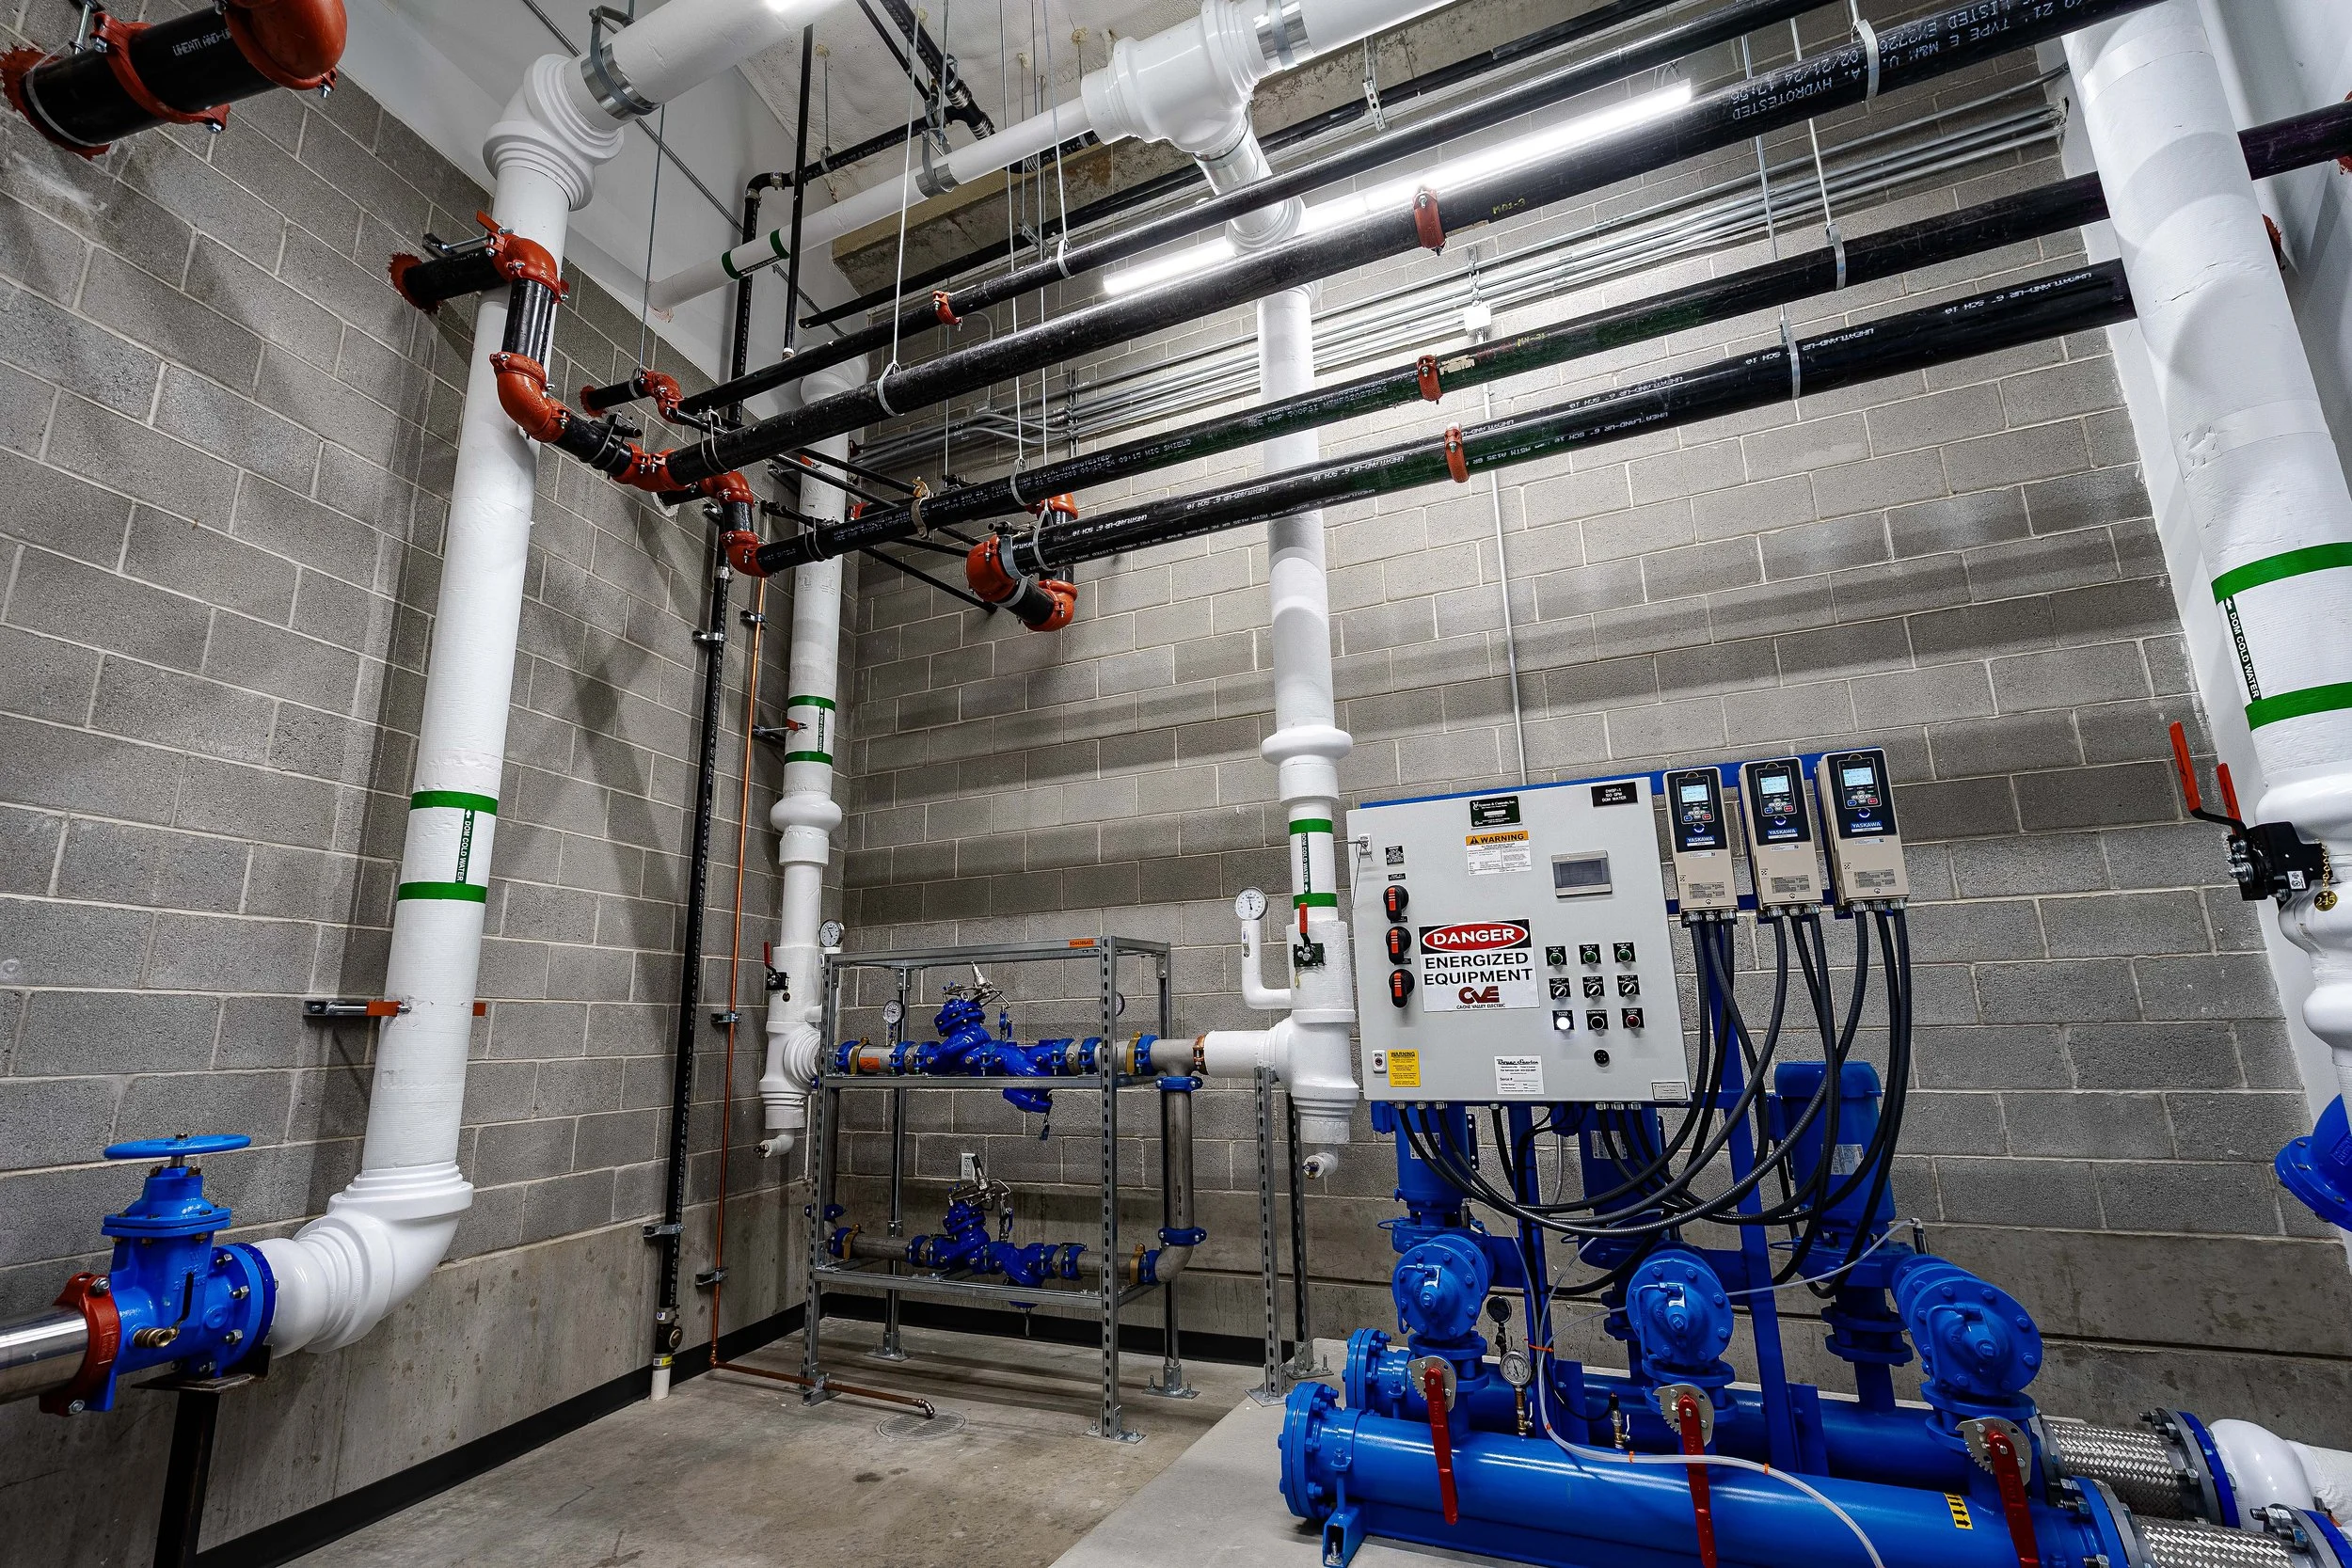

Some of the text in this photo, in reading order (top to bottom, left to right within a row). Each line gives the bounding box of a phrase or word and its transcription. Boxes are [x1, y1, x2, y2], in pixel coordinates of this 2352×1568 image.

[1966, 17, 2010, 40] TYPE
[1947, 34, 1961, 47] E
[1842, 54, 1901, 82] U..A.
[1729, 76, 1835, 120] HYDROTESTED
[1163, 438, 1192, 451] SHIELD
[2227, 611, 2262, 699] DOM COLD WATER
[1768, 827, 1795, 835] YASKAWA
[1851, 820, 1881, 829] YASKAWA
[1480, 832, 1523, 844] WARNING
[1687, 834, 1713, 843] YASKAWA
[454, 819, 472, 881] DOM COLD WATER
[2315, 895, 2336, 907] 245
[1434, 928, 1516, 945] DANGER
[1424, 952, 1528, 969] ENERGIZED
[1424, 969, 1533, 986] EQUIPMENT
[1458, 986, 1500, 1005] CVE
